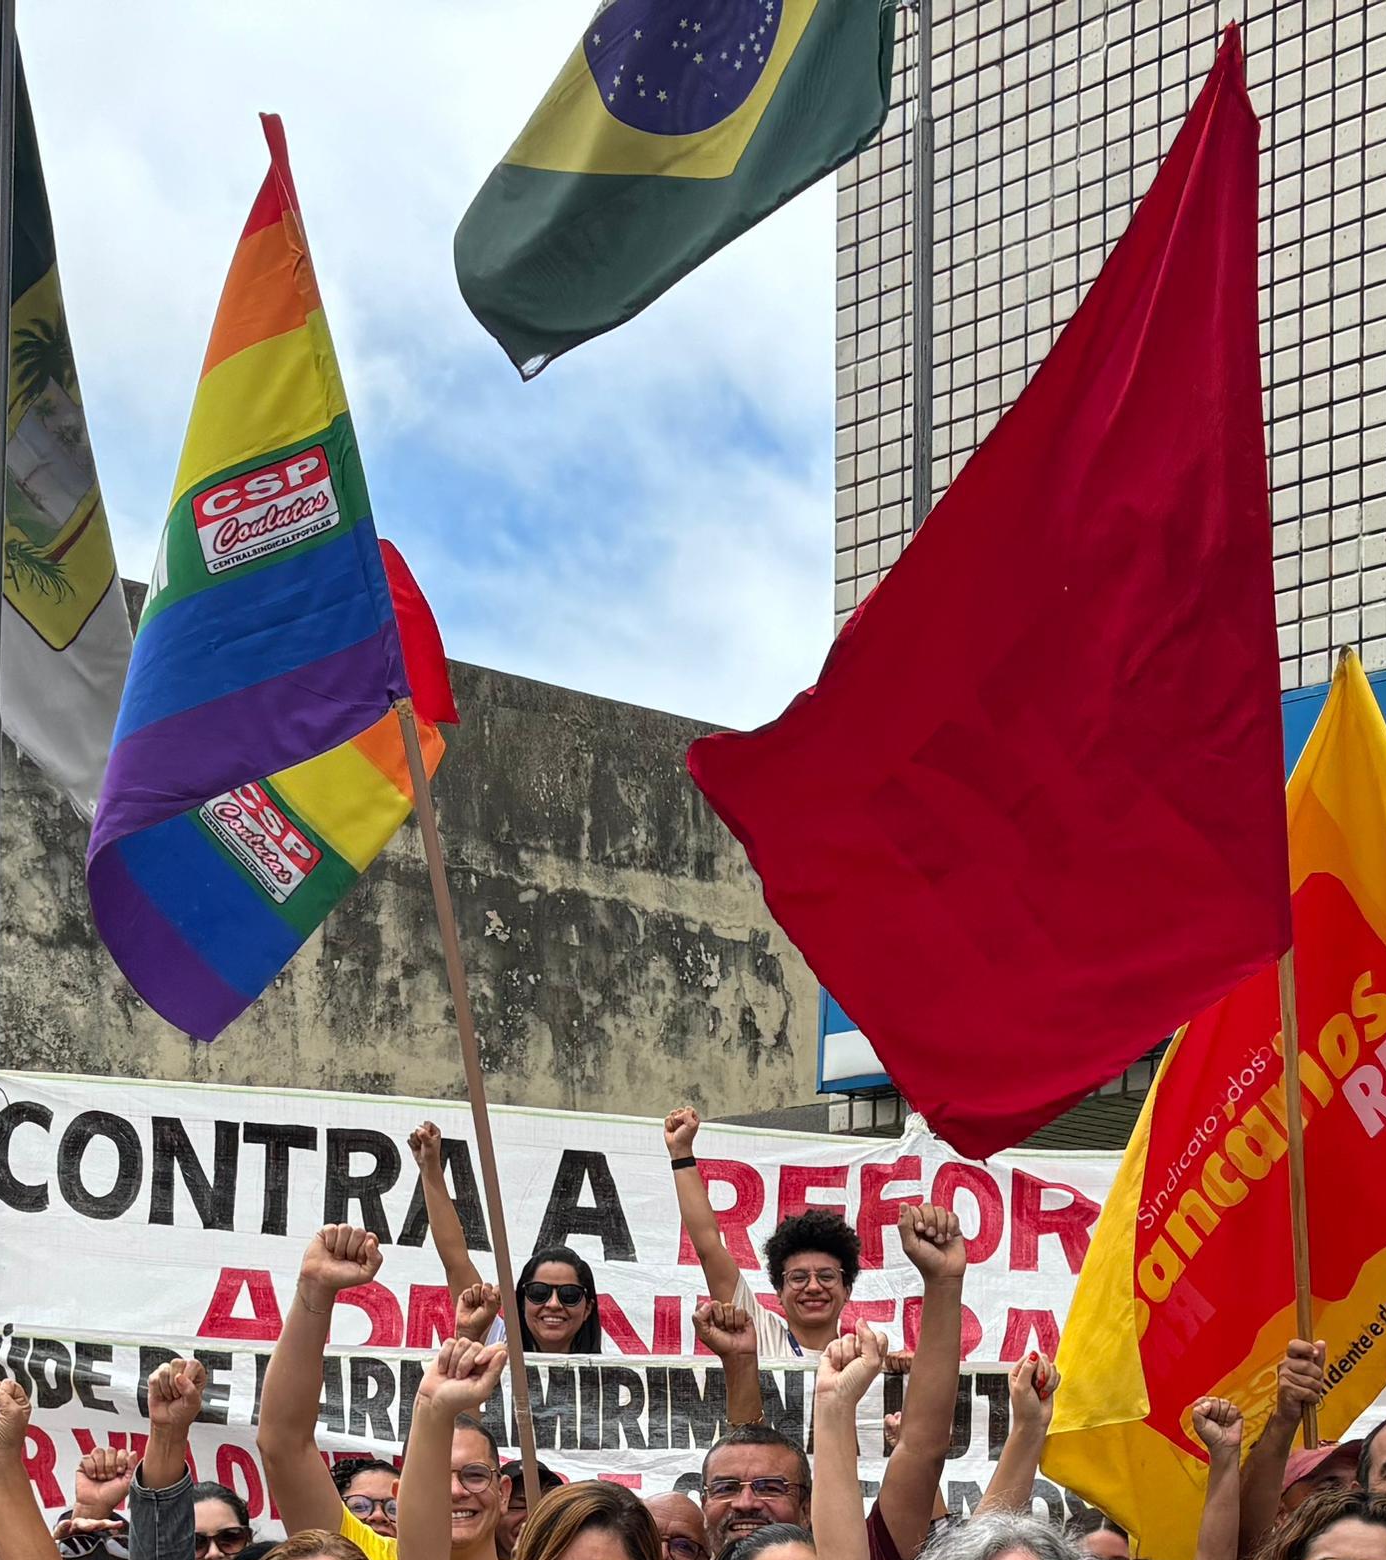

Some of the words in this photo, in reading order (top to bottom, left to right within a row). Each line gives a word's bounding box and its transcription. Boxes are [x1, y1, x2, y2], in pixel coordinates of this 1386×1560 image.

[202, 457, 320, 516] CSP
[213, 491, 329, 555] Conlutas
[213, 802, 292, 885] Conlutas
[234, 783, 312, 860] CSP
[1136, 1113, 1218, 1231] Sindicato
[1227, 1052, 1269, 1104] dos
[532, 1149, 639, 1263] A
